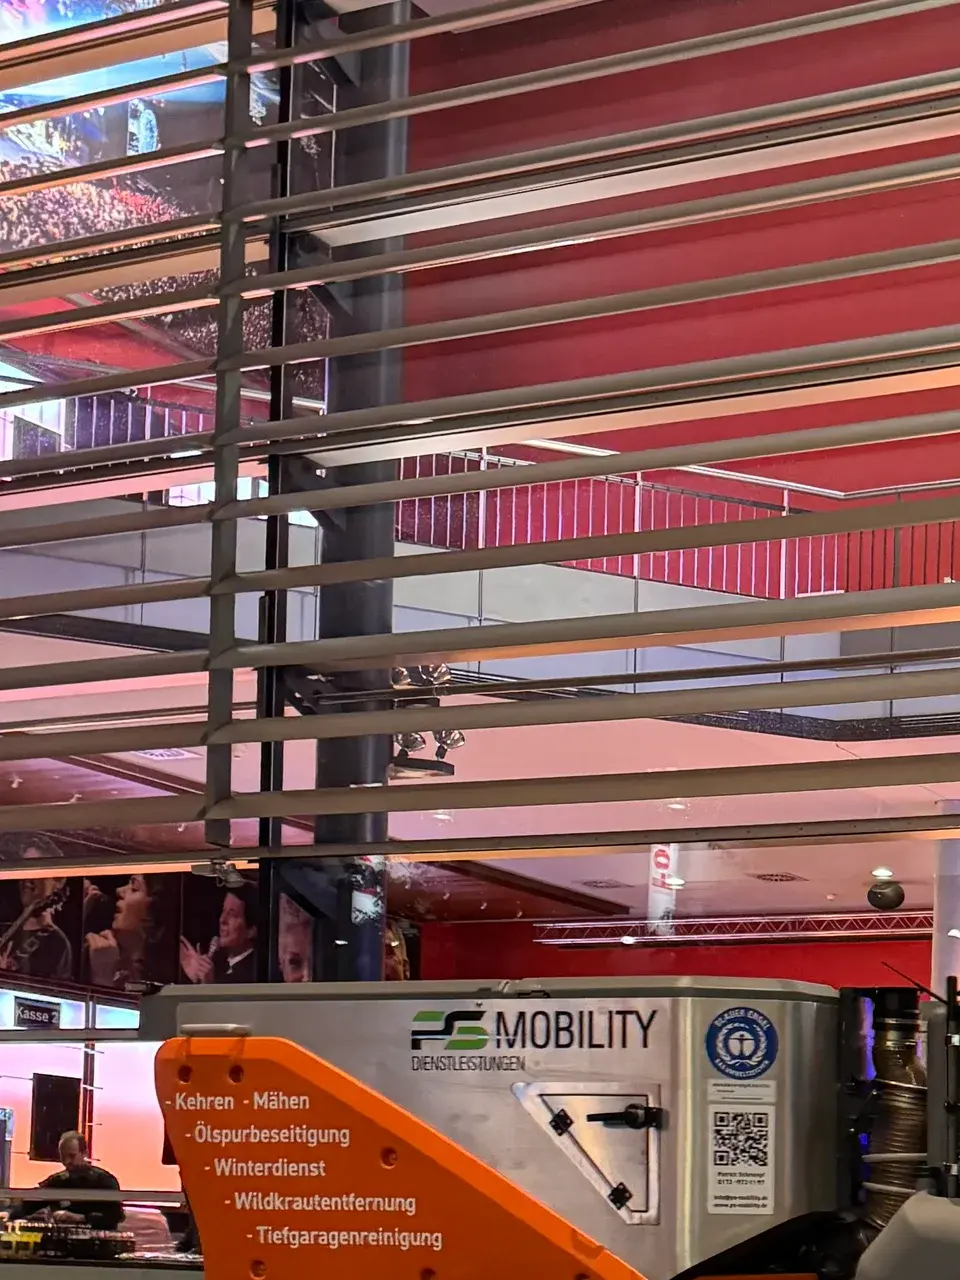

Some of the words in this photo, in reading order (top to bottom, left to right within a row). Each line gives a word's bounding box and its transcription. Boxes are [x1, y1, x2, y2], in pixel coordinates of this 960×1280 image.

[16, 1006, 49, 1022] Kasse
[52, 1012, 59, 1024] 2
[496, 1010, 659, 1050] MOBILITY
[411, 1055, 526, 1072] DIENSTLEISTUNGEN
[175, 1092, 234, 1110] Kehren
[253, 1091, 310, 1110] Mähen
[194, 1120, 350, 1147] Ölspurbeseitigung
[214, 1158, 326, 1177] Winterdienst
[234, 1192, 416, 1215] Wildkrautentfernung
[256, 1226, 443, 1251] Tiefgaragenreinigung
